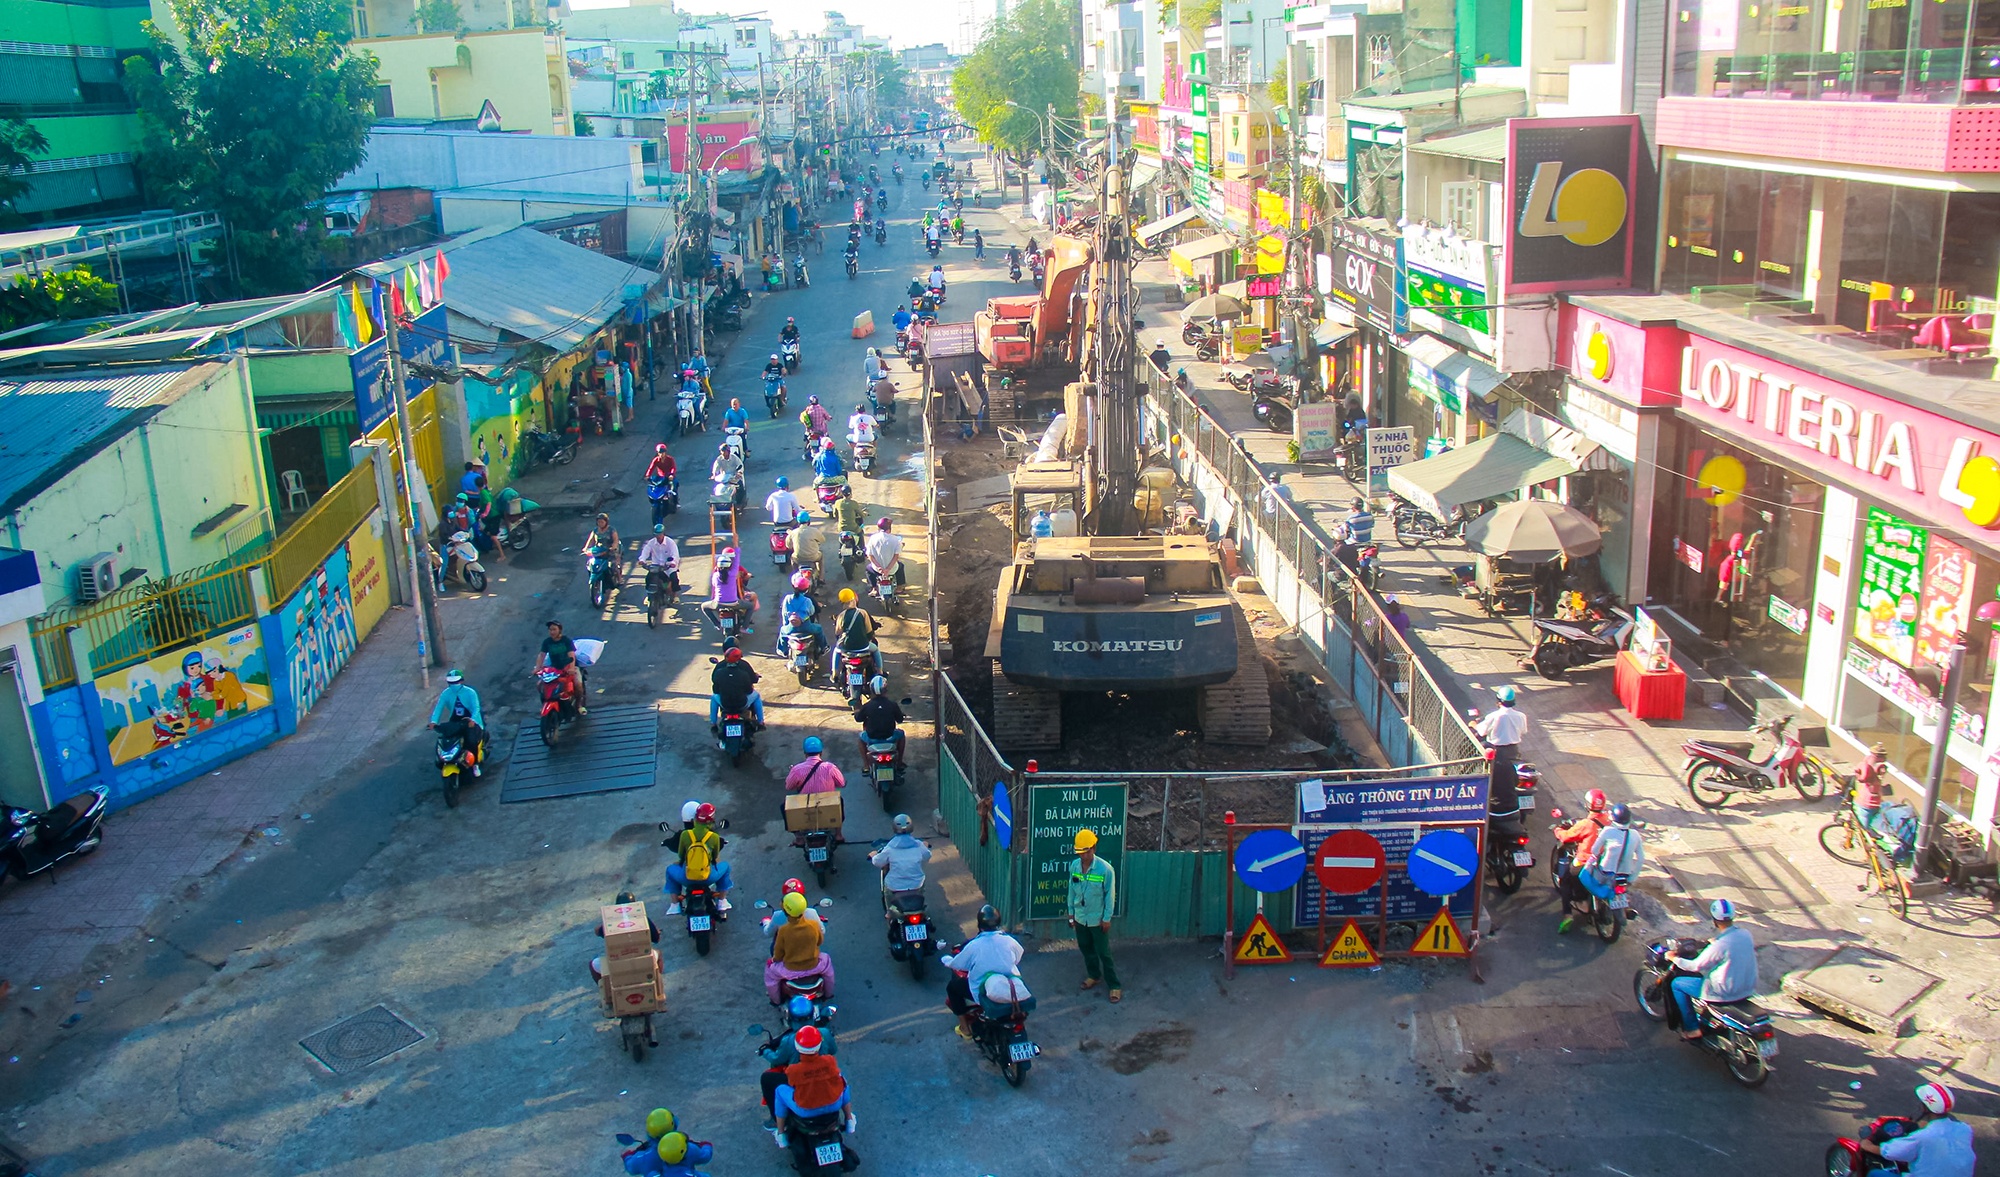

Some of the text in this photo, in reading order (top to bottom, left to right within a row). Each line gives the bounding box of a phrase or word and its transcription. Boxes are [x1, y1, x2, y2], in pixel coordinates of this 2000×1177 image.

[702, 133, 726, 144] âm
[1681, 347, 1923, 494] LOTTERIA
[1385, 430, 1408, 442] NHÀ
[1372, 441, 1410, 455] THUỐC
[1380, 455, 1402, 465] TÂY
[1053, 639, 1184, 652] KOMATSU
[1062, 790, 1079, 802] XIN
[1325, 788, 1355, 806] ẢNG
[1359, 788, 1405, 804] THÔNG
[1408, 788, 1432, 802] TIN
[1434, 785, 1455, 802] DỰ
[1045, 803, 1113, 820] ĐÃ LÀM PHIỀN
[1034, 827, 1063, 839] MONG
[1101, 821, 1122, 836] CẢM
[1041, 858, 1059, 873] BẤT
[1037, 880, 1049, 890] WE
[1344, 936, 1357, 946] ĐI
